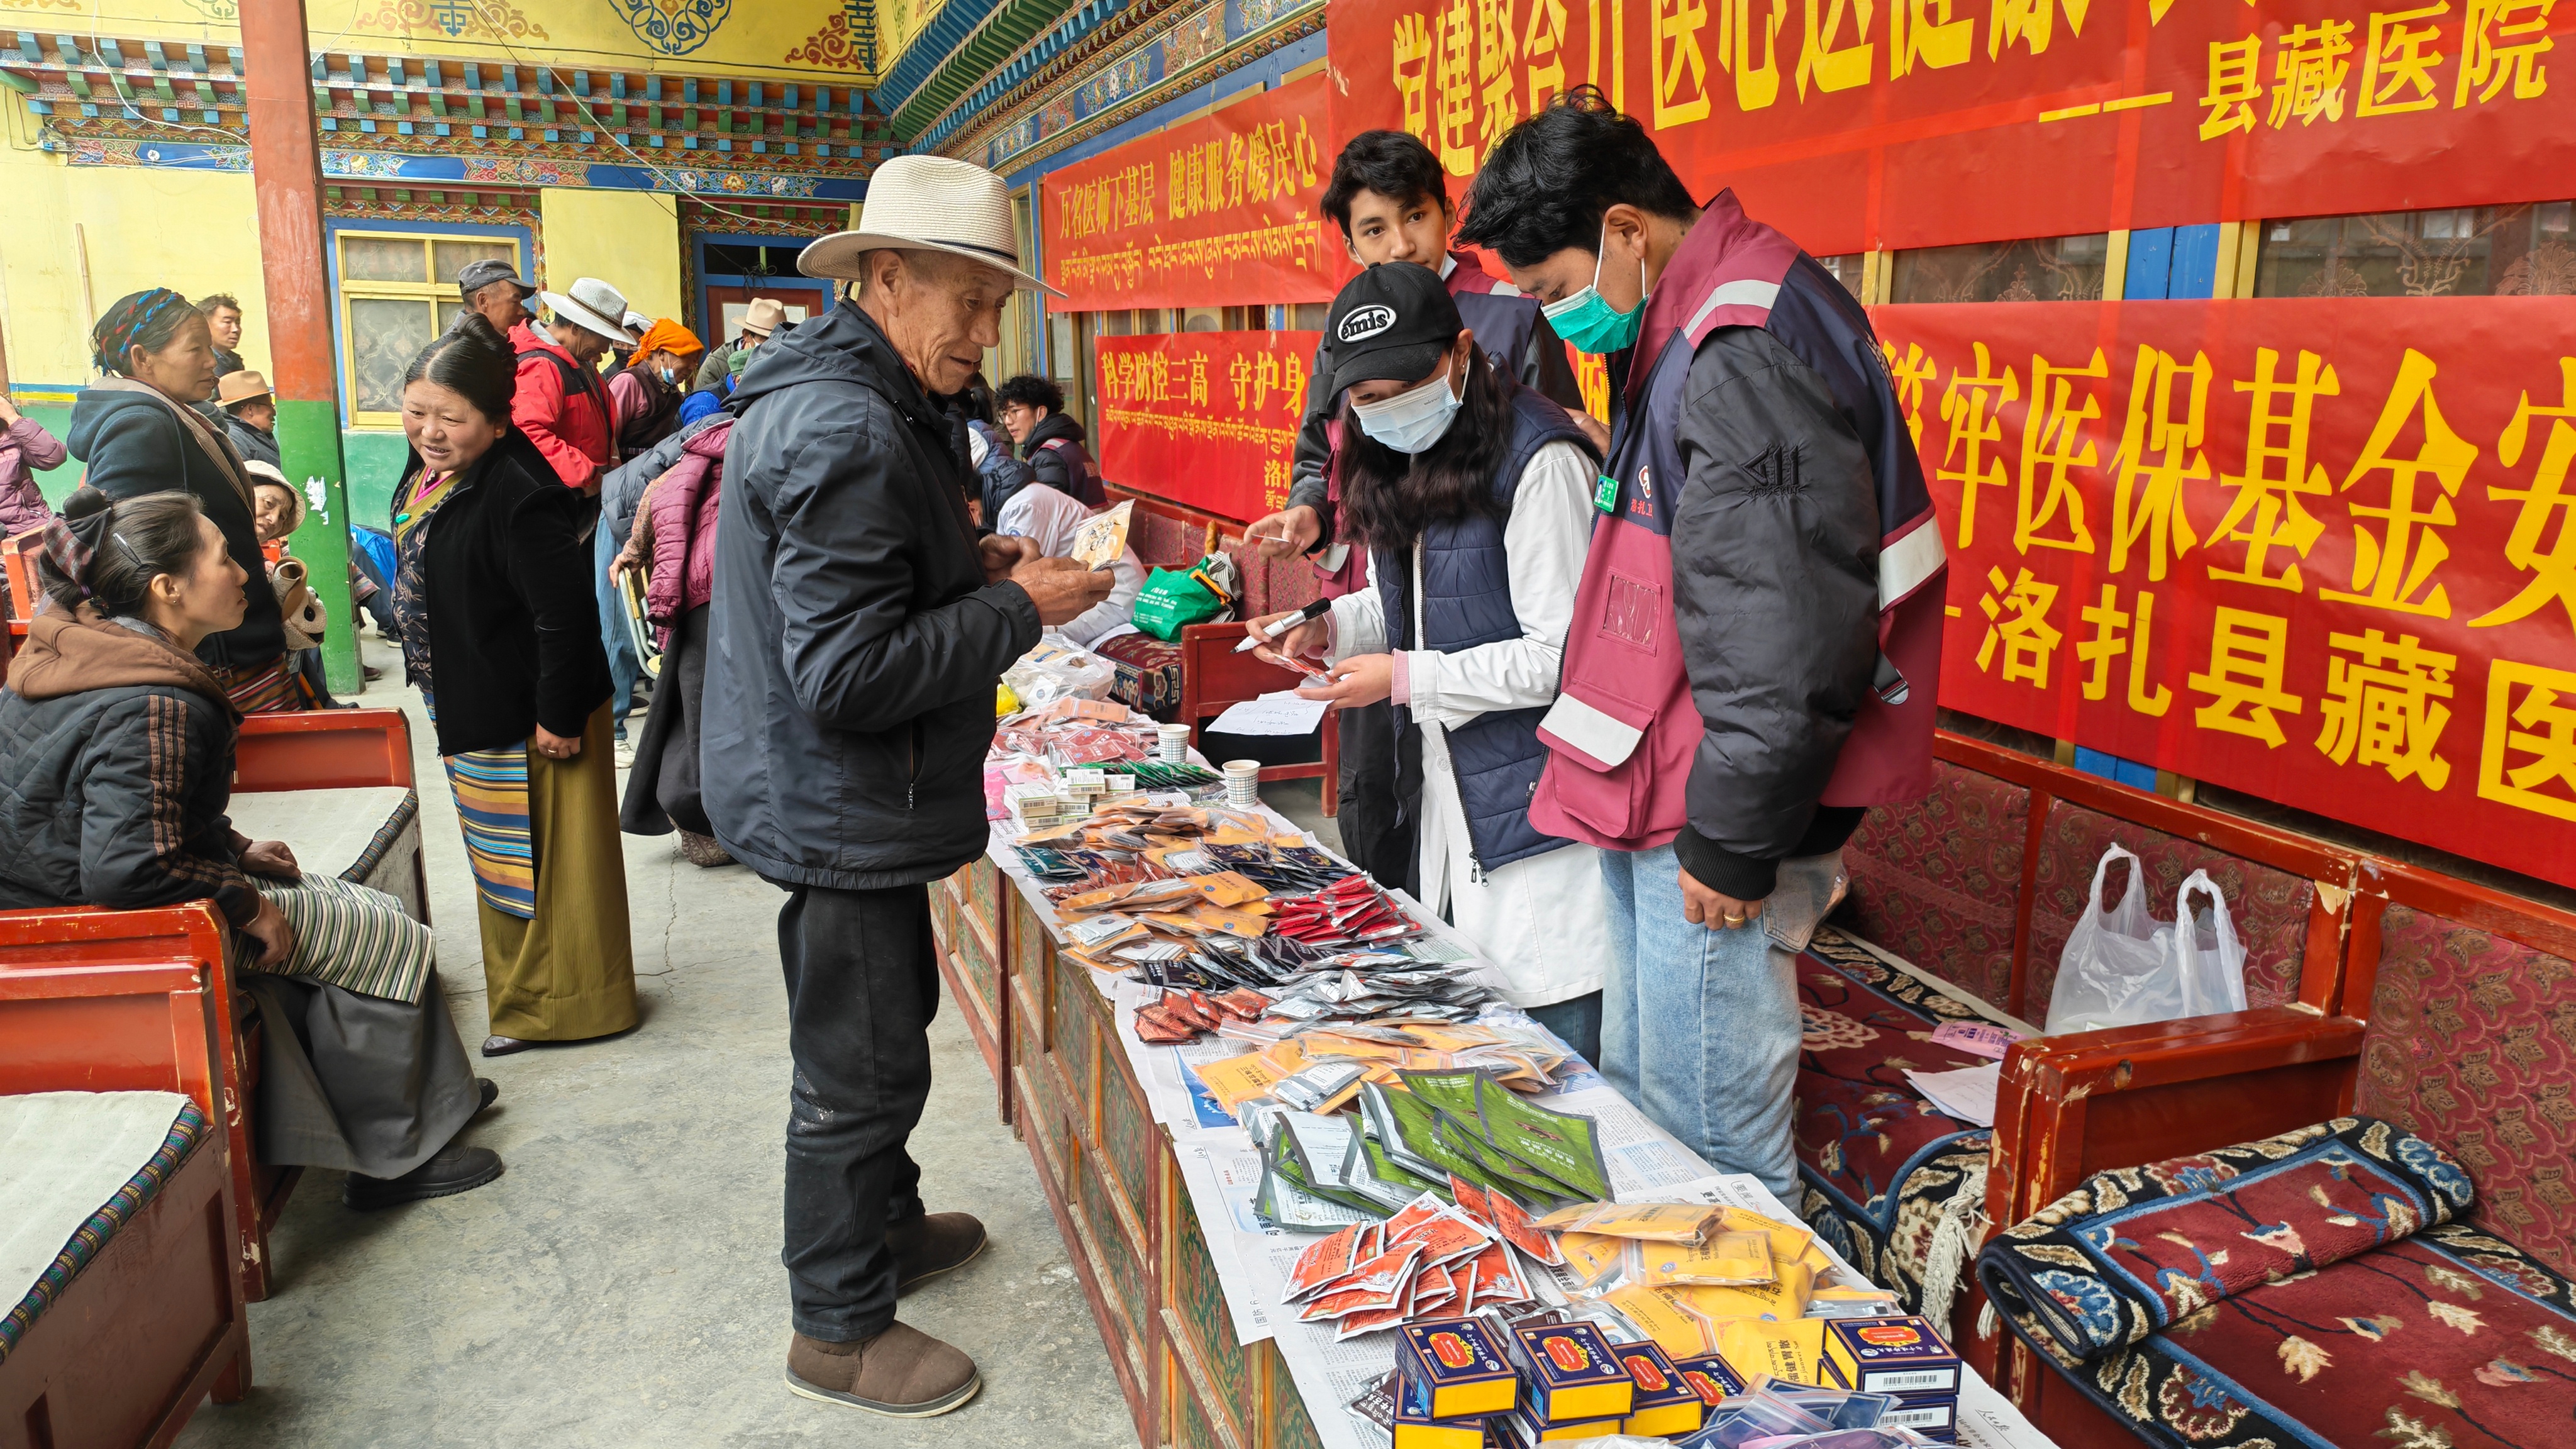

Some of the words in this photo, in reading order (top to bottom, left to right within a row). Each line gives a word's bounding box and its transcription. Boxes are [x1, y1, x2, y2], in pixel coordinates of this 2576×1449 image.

[1058, 161, 1156, 240] 万名医师下基层
[1169, 114, 1317, 221] 健康服务暖民心
[1340, 306, 1390, 340] emis
[1101, 350, 1208, 408] 科学防控三高
[1230, 350, 1306, 418] 守护身
